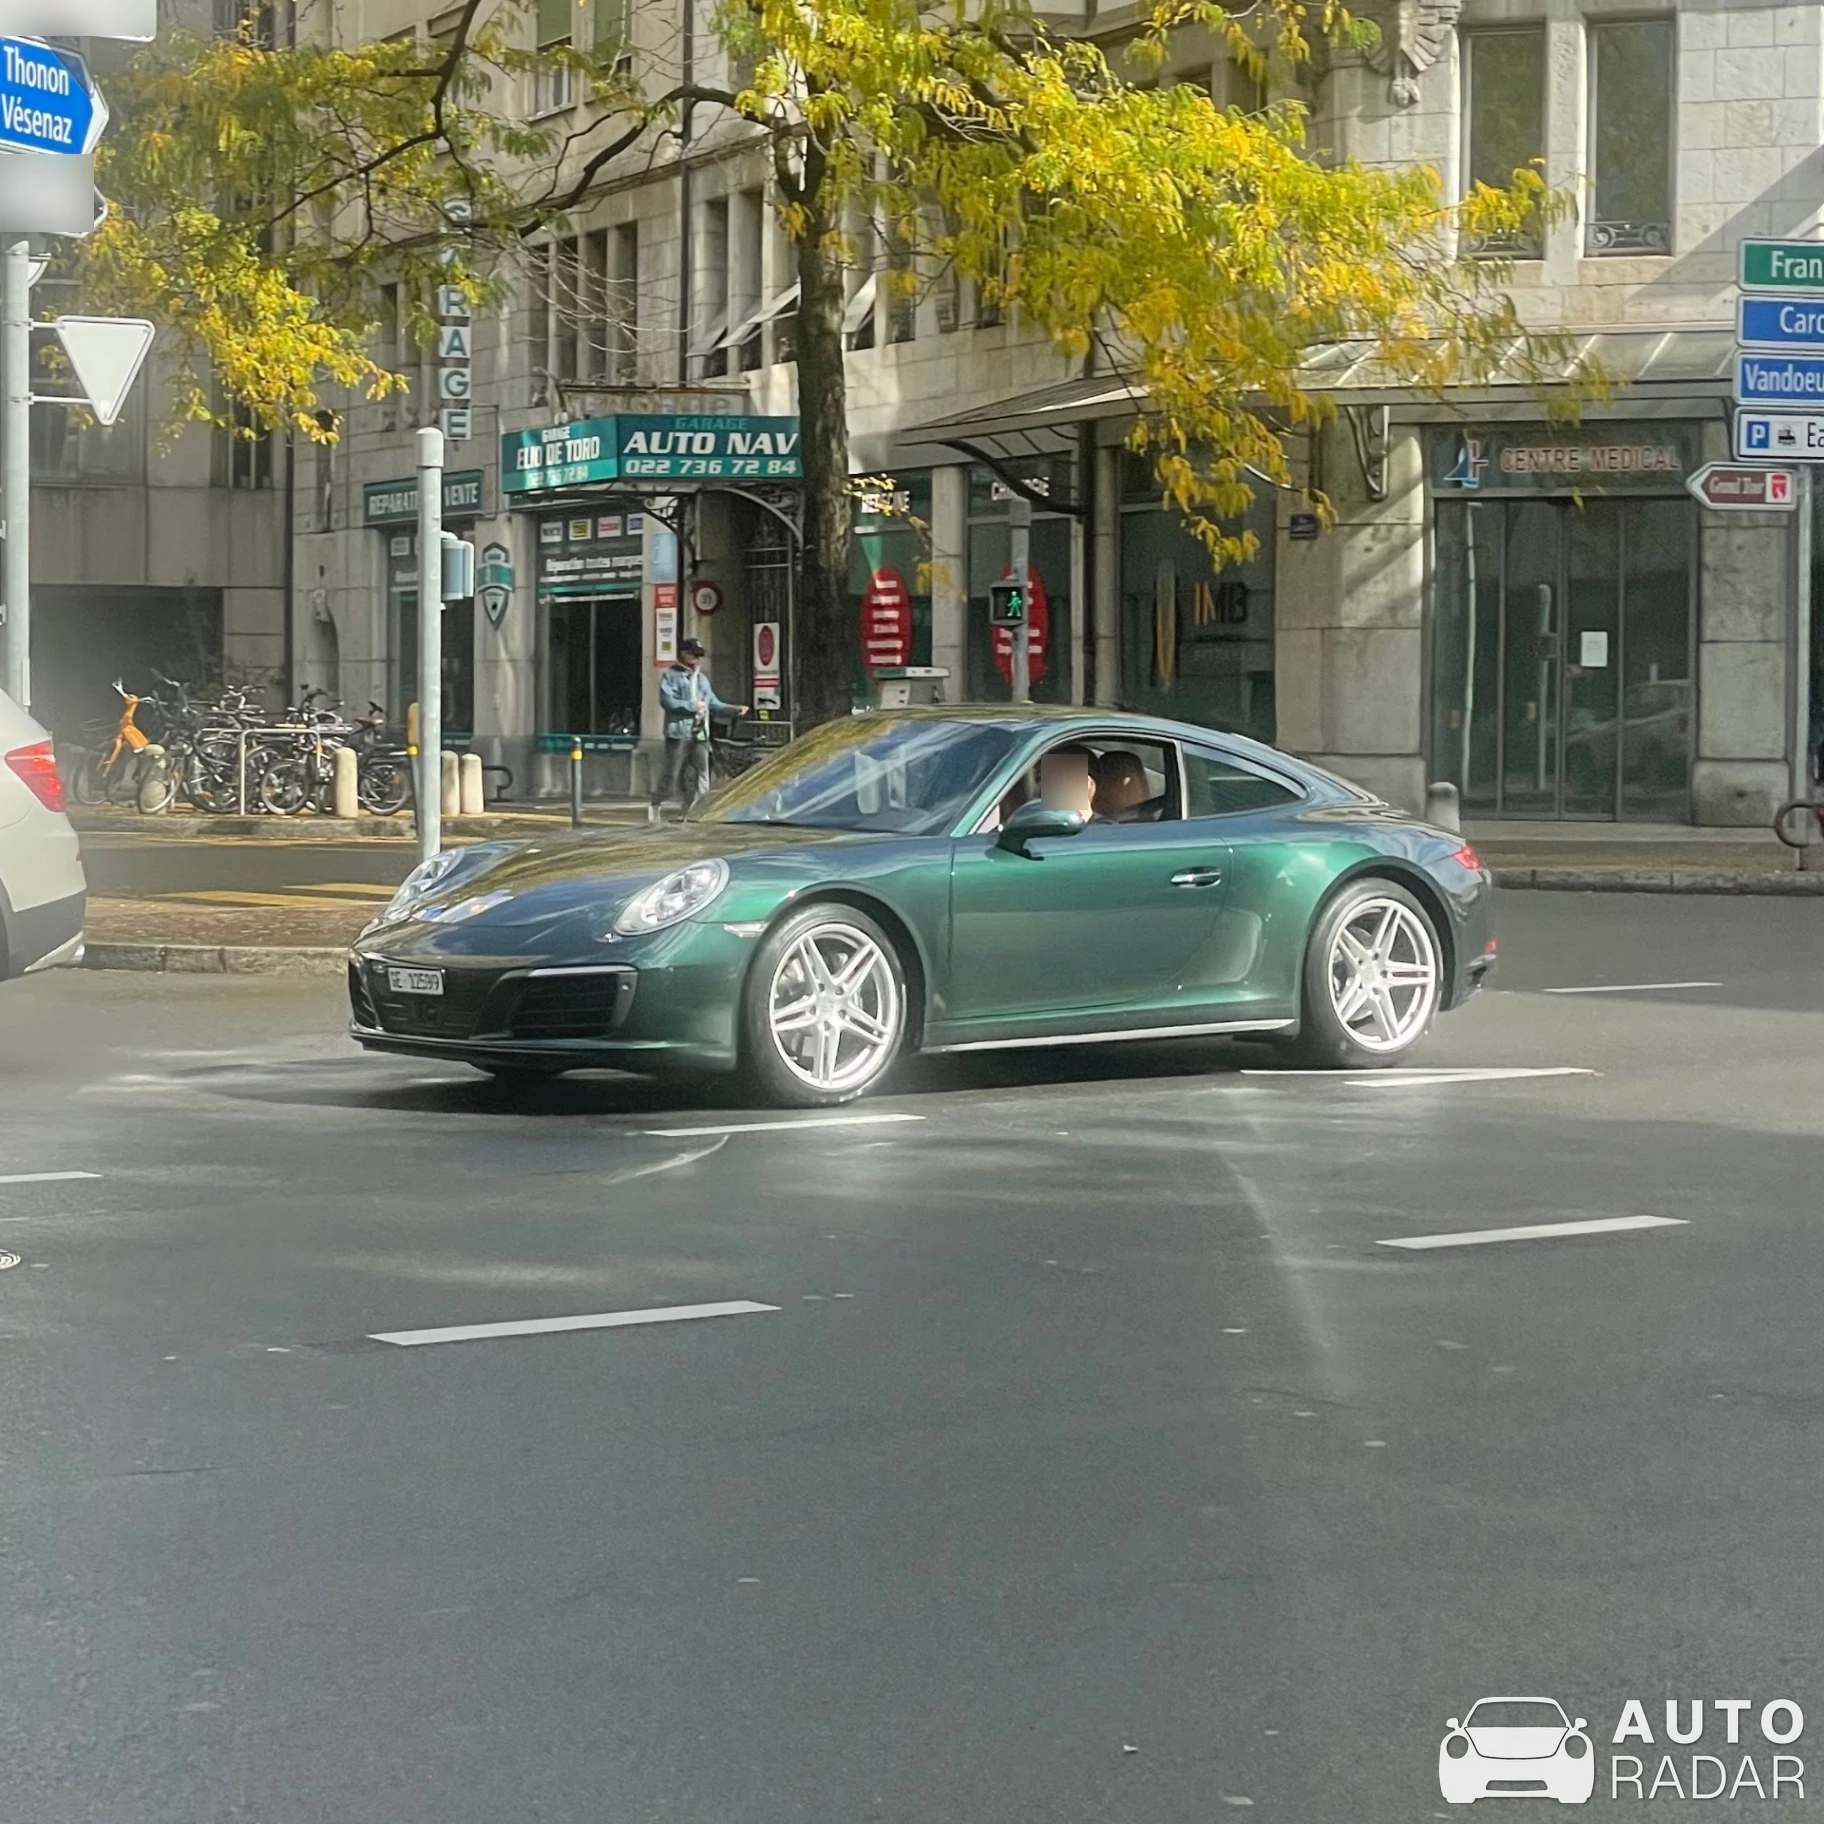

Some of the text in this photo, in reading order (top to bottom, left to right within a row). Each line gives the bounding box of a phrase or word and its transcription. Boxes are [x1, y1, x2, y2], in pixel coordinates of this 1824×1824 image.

[3, 46, 70, 96] Thonon
[1, 93, 72, 144] Vésenaz
[1770, 250, 1824, 279] Fran
[675, 417, 748, 431] GARAGE
[1751, 424, 1766, 446] P
[546, 442, 563, 466] DE
[565, 436, 600, 462] TORO
[623, 431, 798, 455] AUTO NAV
[625, 459, 796, 474] 022 736 72 84
[1501, 445, 1682, 472] CENTRE MEDICAL
